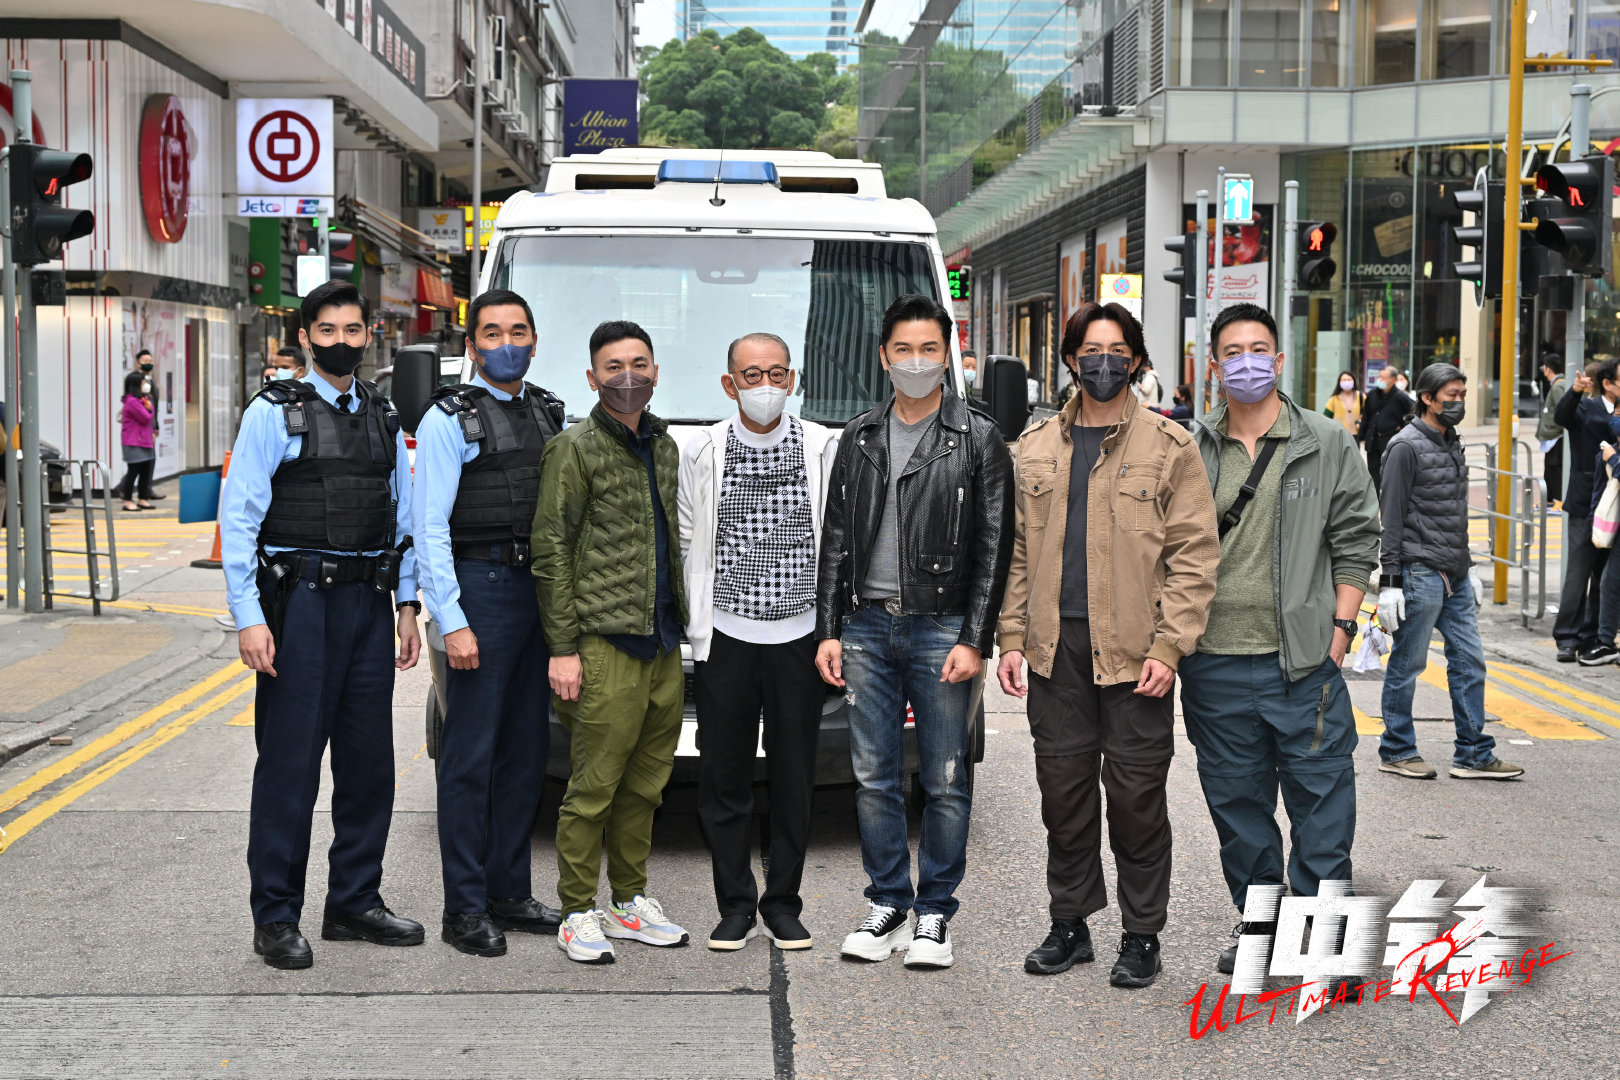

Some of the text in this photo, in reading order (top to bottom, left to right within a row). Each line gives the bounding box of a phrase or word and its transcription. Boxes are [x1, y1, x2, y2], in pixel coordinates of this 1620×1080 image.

[570, 110, 628, 127] Albion
[574, 129, 625, 147] Plaza
[948, 271, 960, 279] P1
[949, 280, 961, 289] P2
